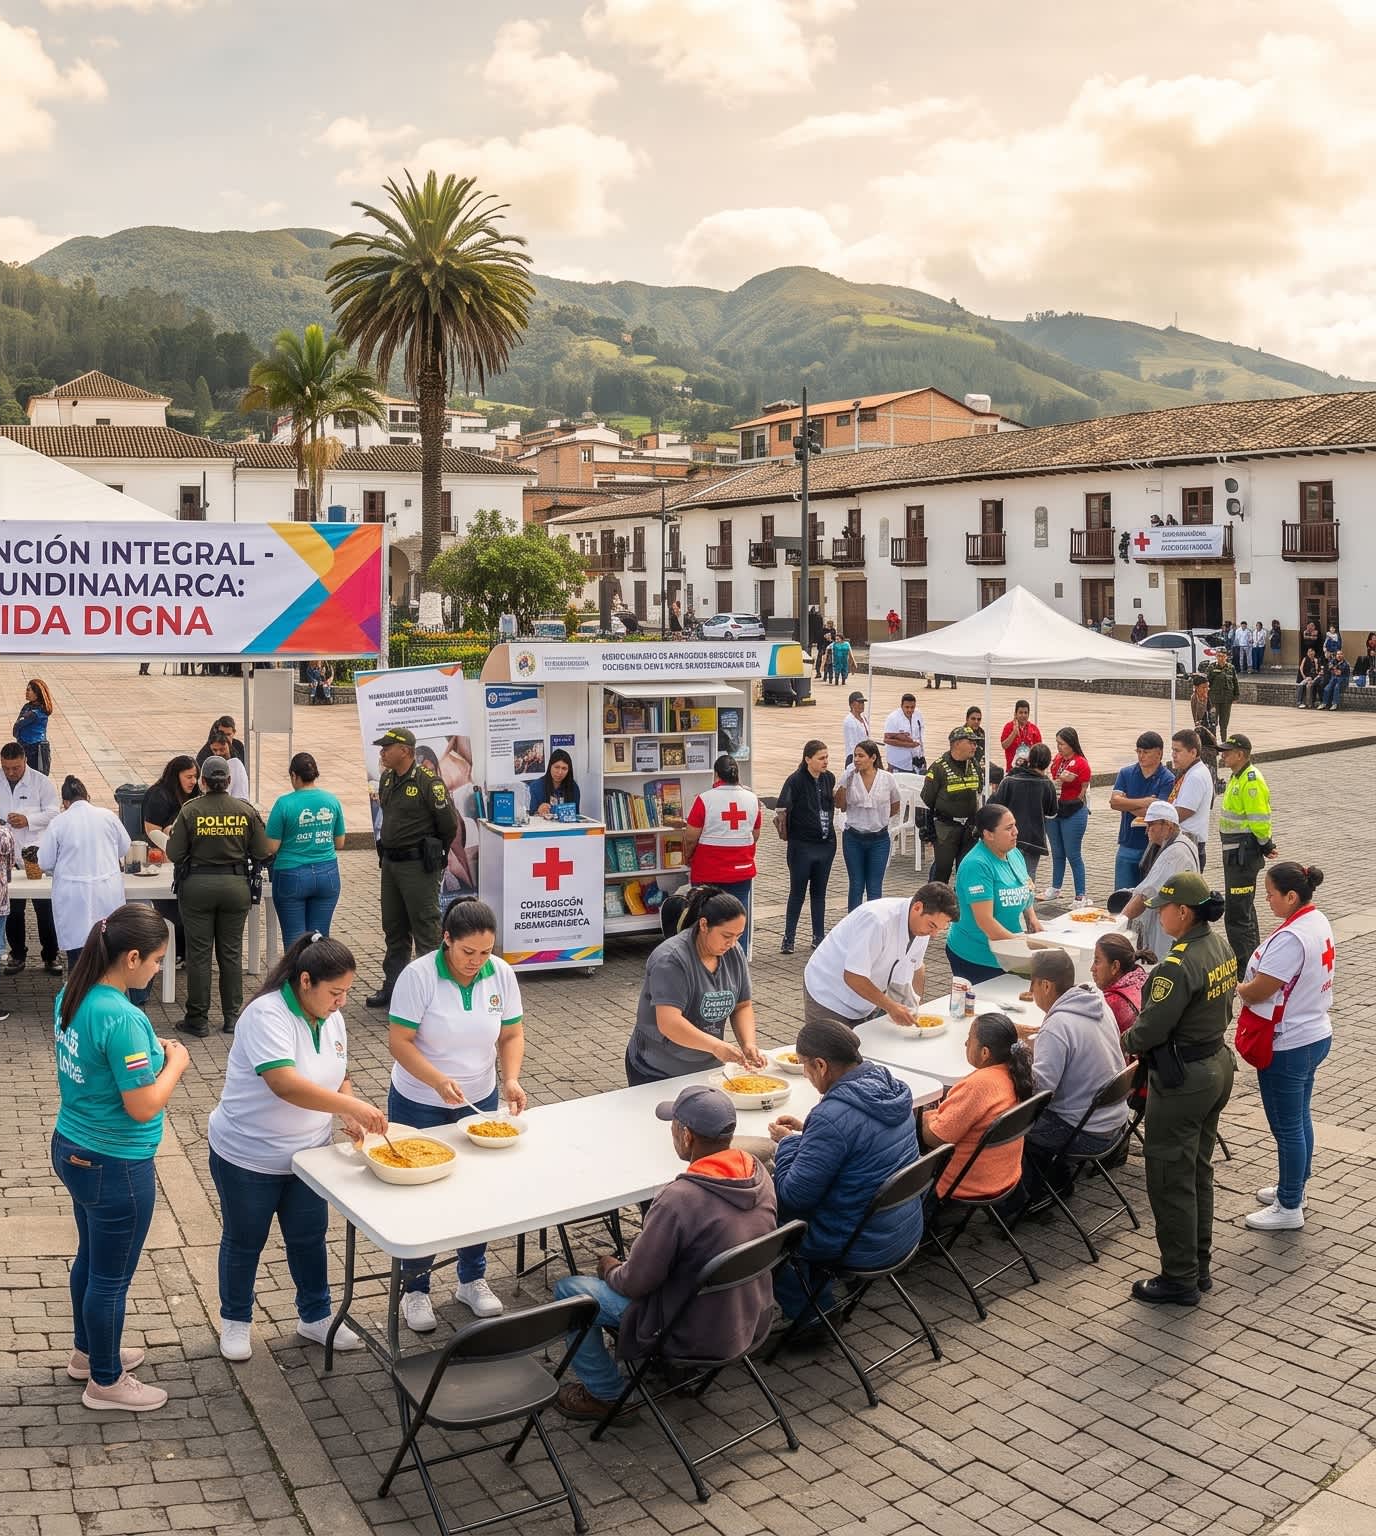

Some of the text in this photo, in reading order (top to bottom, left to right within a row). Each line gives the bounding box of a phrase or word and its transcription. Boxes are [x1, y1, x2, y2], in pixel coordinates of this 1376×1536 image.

[102, 541, 254, 565] INTEGRAL
[84, 605, 213, 635] DIGNA
[197, 815, 248, 827] POLICIA
